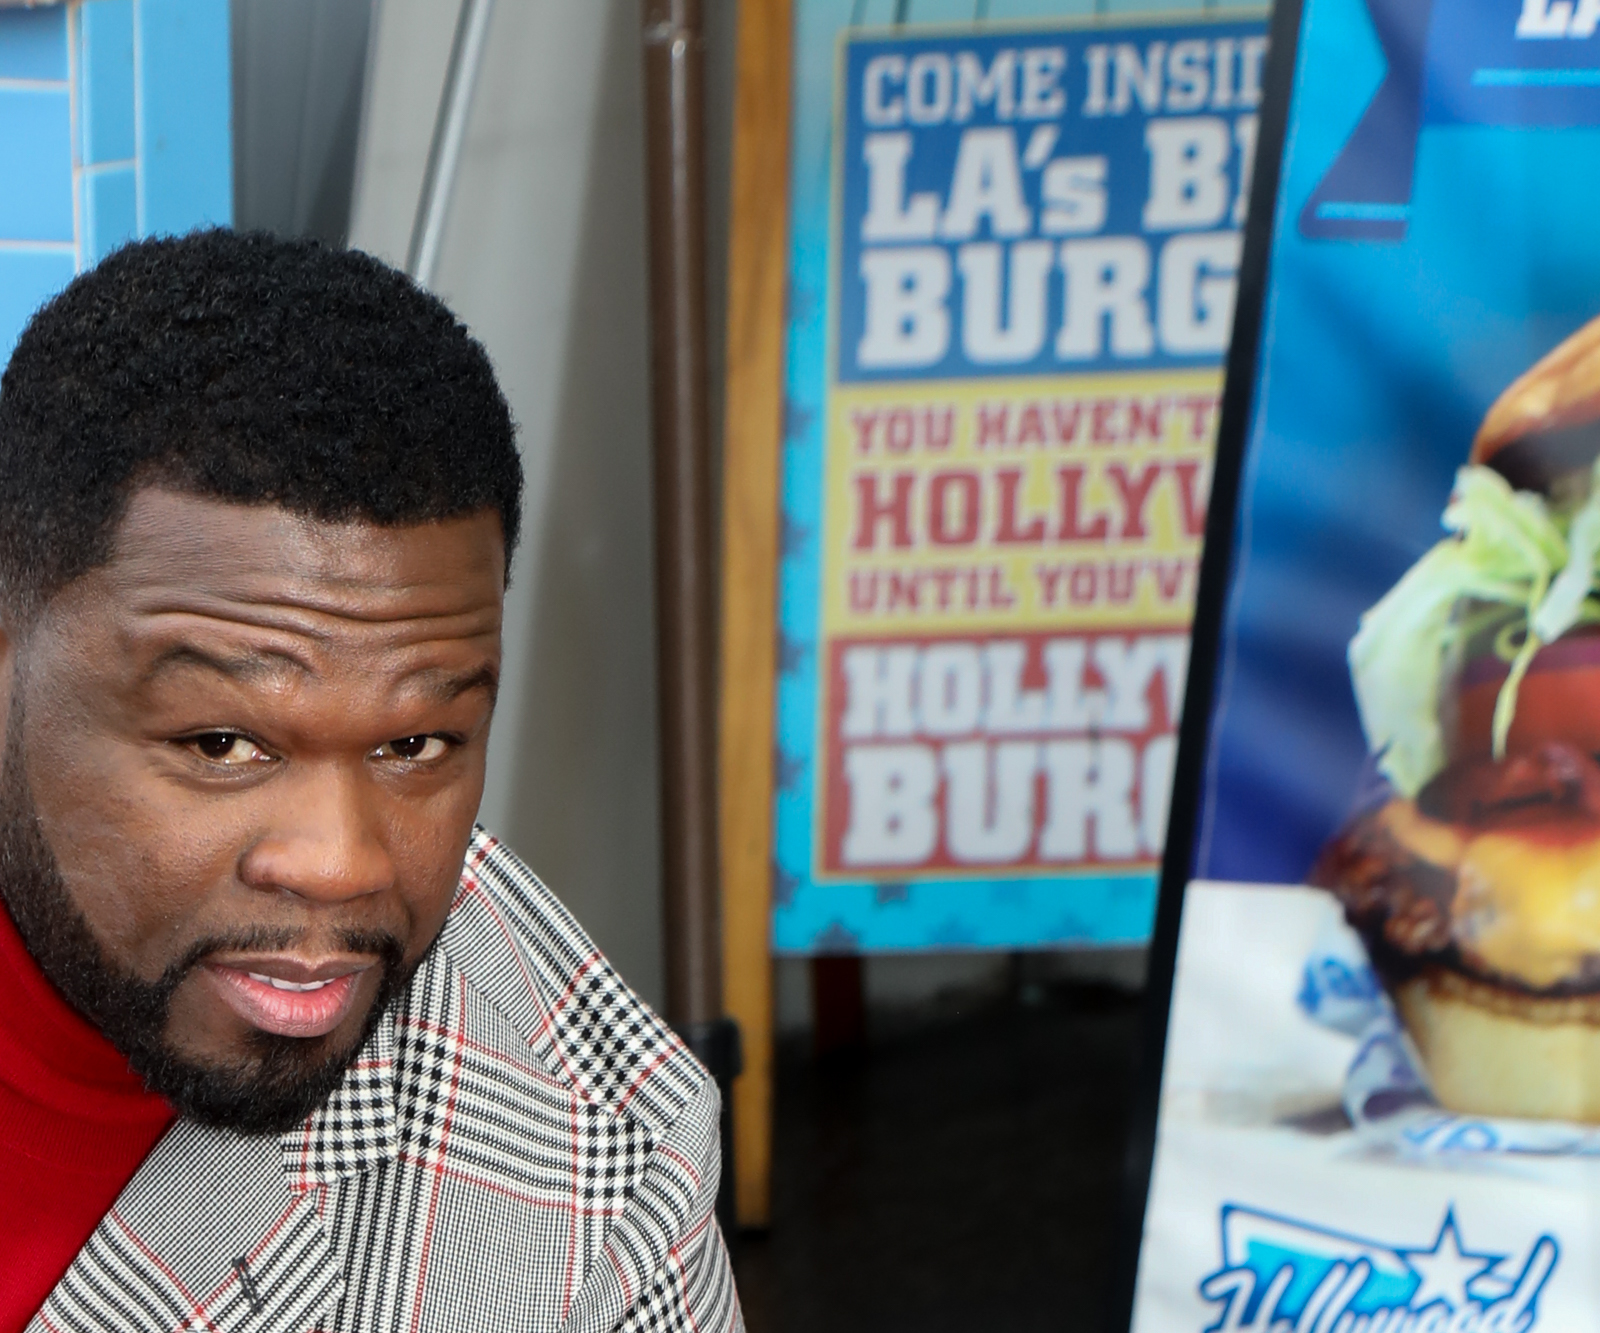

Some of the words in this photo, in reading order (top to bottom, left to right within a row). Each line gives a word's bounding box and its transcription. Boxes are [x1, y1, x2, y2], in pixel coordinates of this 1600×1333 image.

[862, 48, 1066, 127] COME
[861, 123, 1108, 242] LA's
[856, 231, 1244, 370] BURG
[852, 403, 953, 456] YOU
[977, 395, 1222, 449] HAVEN'T
[848, 567, 1016, 615] UNTIL
[1036, 557, 1199, 608] YOU'V
